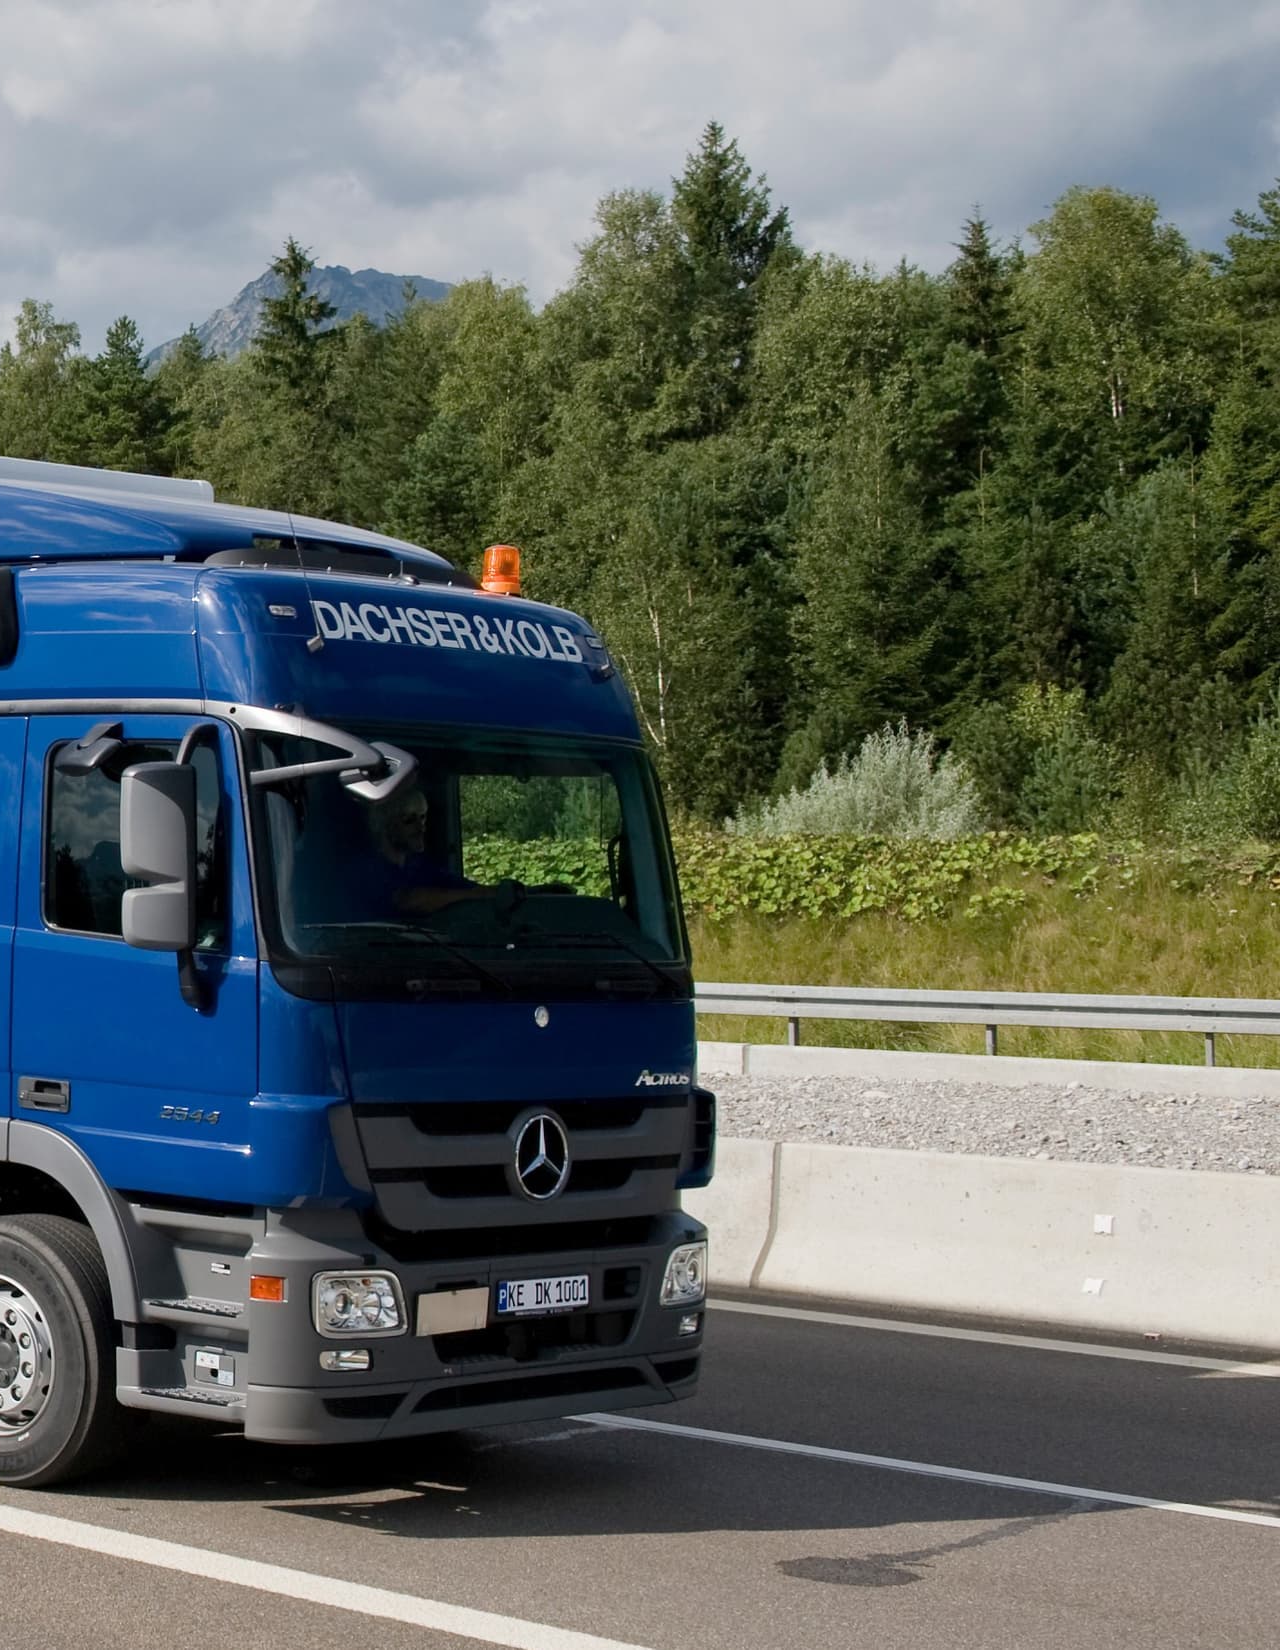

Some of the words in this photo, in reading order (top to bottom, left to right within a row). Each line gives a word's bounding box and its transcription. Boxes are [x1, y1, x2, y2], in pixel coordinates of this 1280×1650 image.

[310, 600, 481, 651] DACHSER
[473, 615, 505, 654] &
[494, 618, 583, 663] KOLB
[508, 1284, 524, 1307] KE
[536, 1281, 551, 1304] DK
[556, 1279, 587, 1303] 1001
